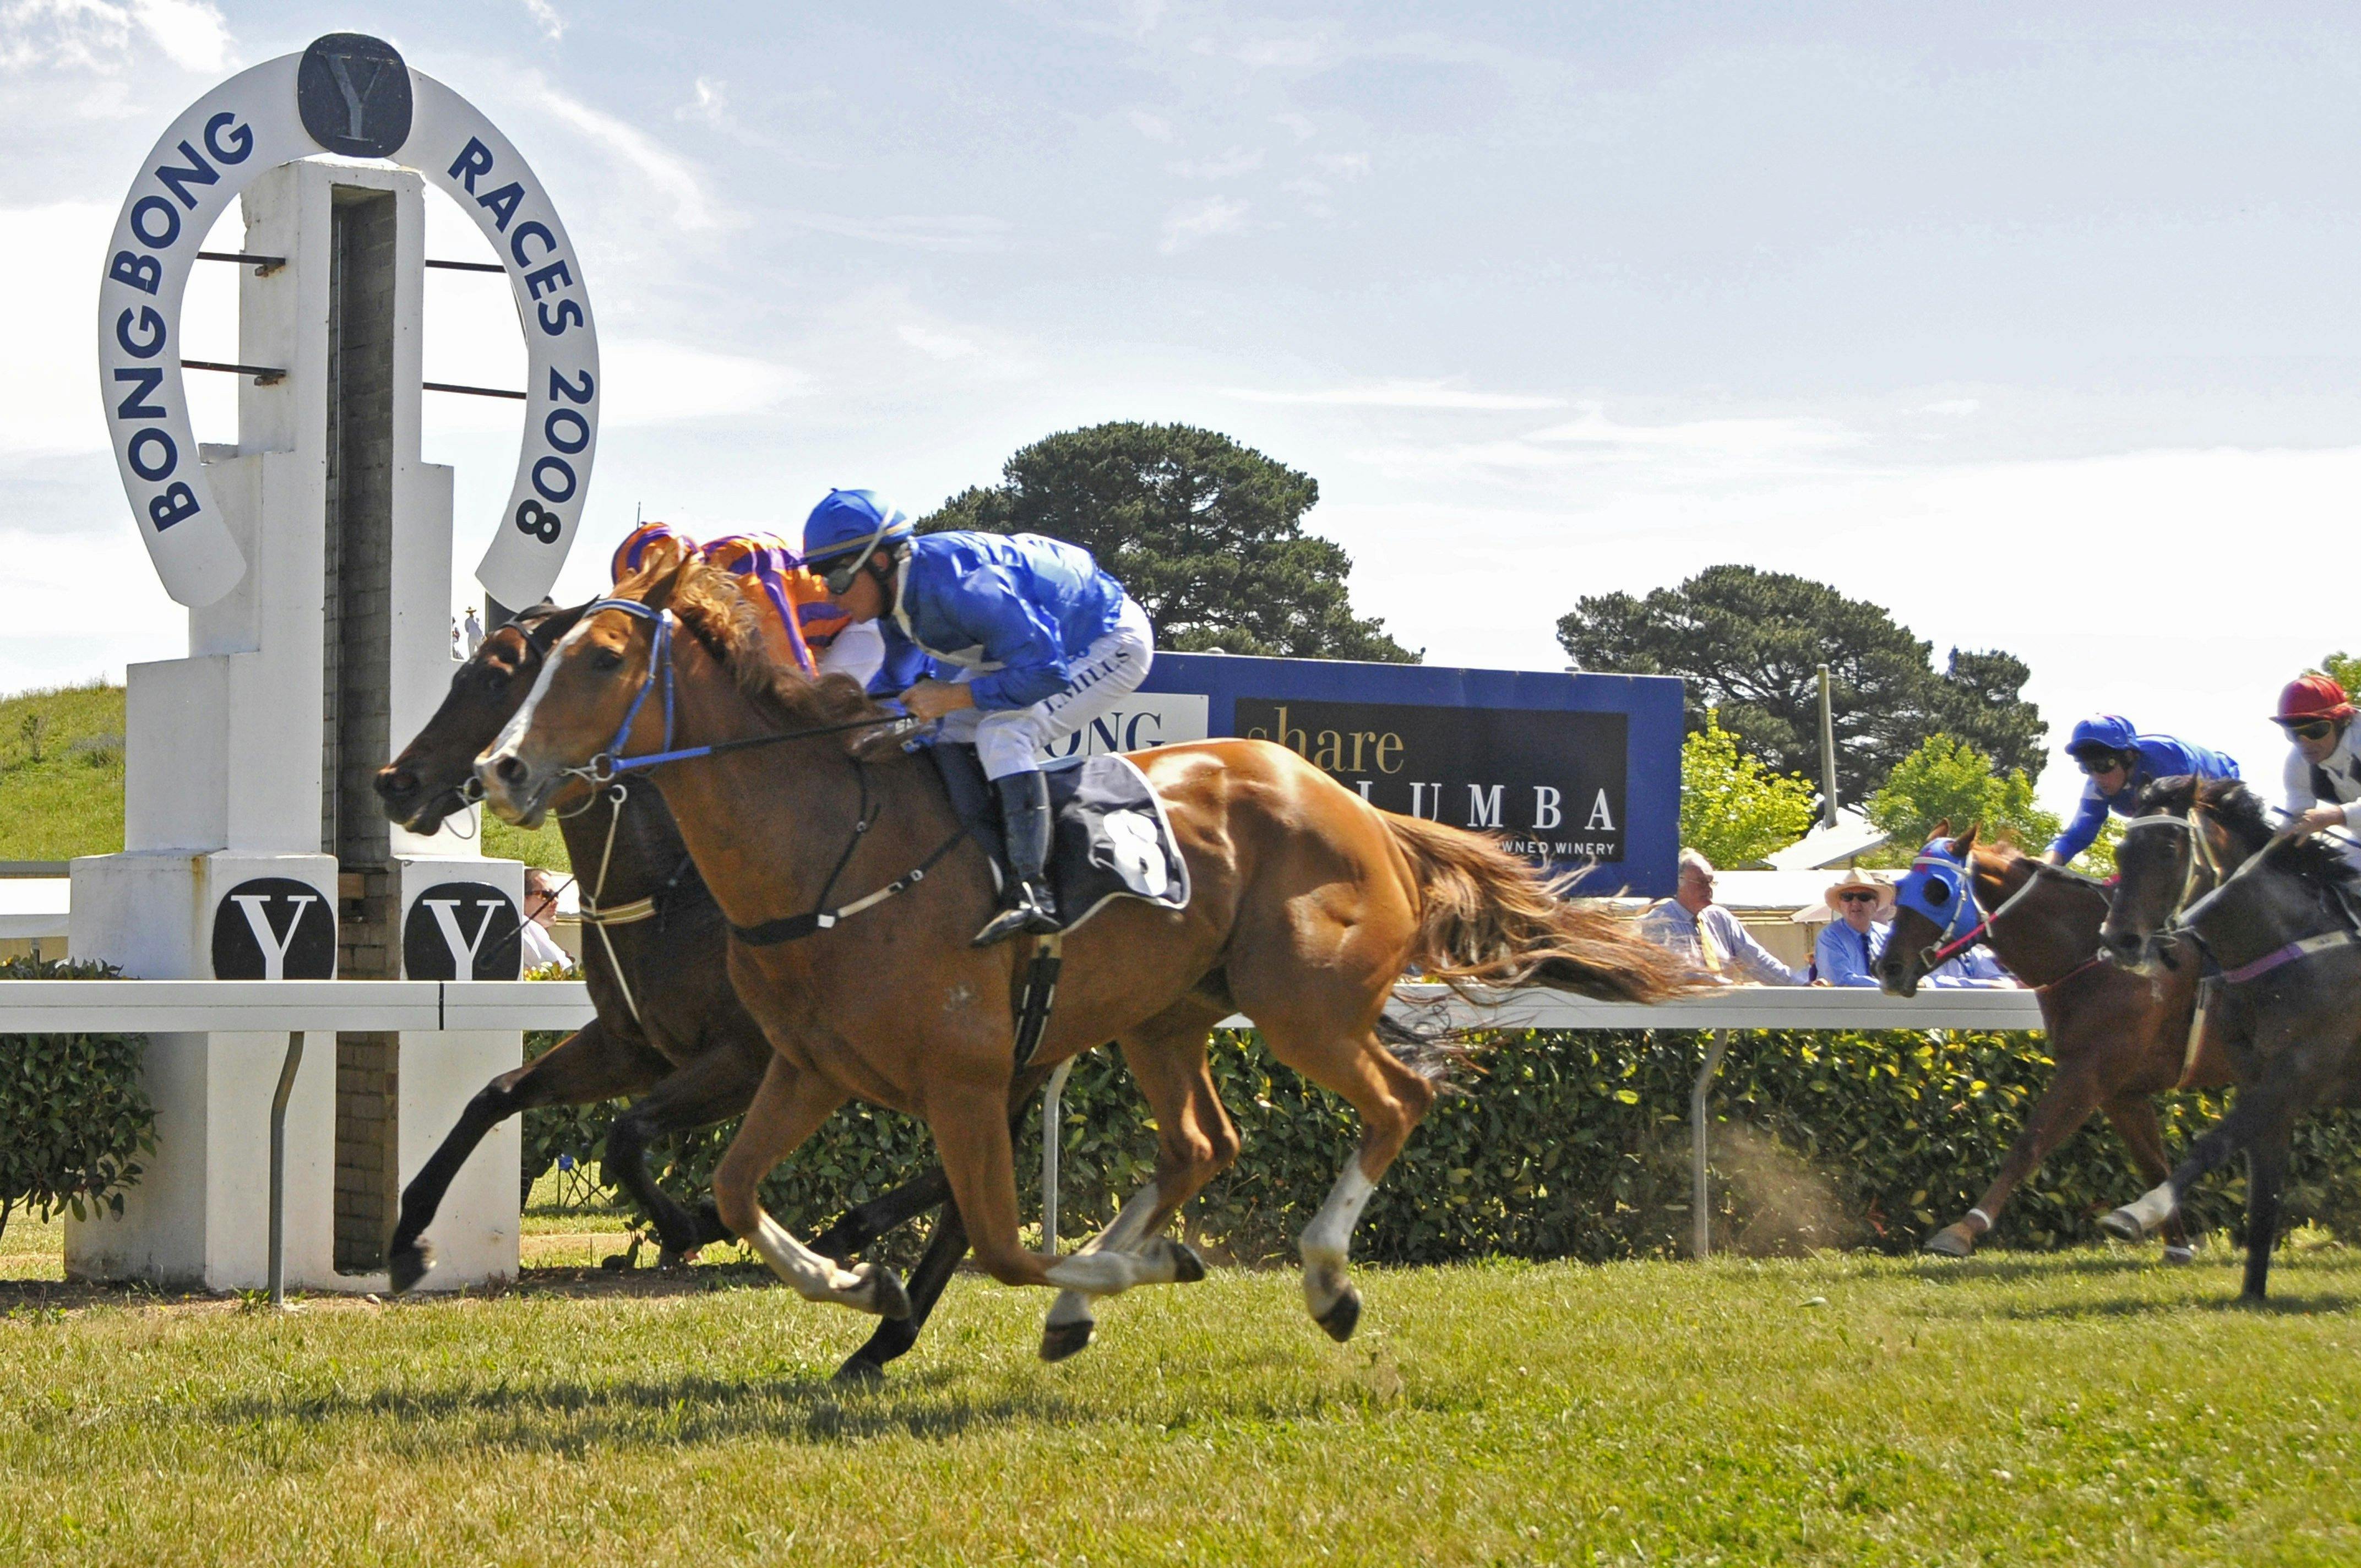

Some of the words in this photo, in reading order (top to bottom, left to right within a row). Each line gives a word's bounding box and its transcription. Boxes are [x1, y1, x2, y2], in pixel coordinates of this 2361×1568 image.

[317, 50, 398, 141] Y
[448, 136, 584, 336] RACES
[516, 366, 594, 543] 2008
[1555, 842, 1615, 855] WINERY
[231, 895, 317, 980] Y
[422, 899, 505, 980] Y
